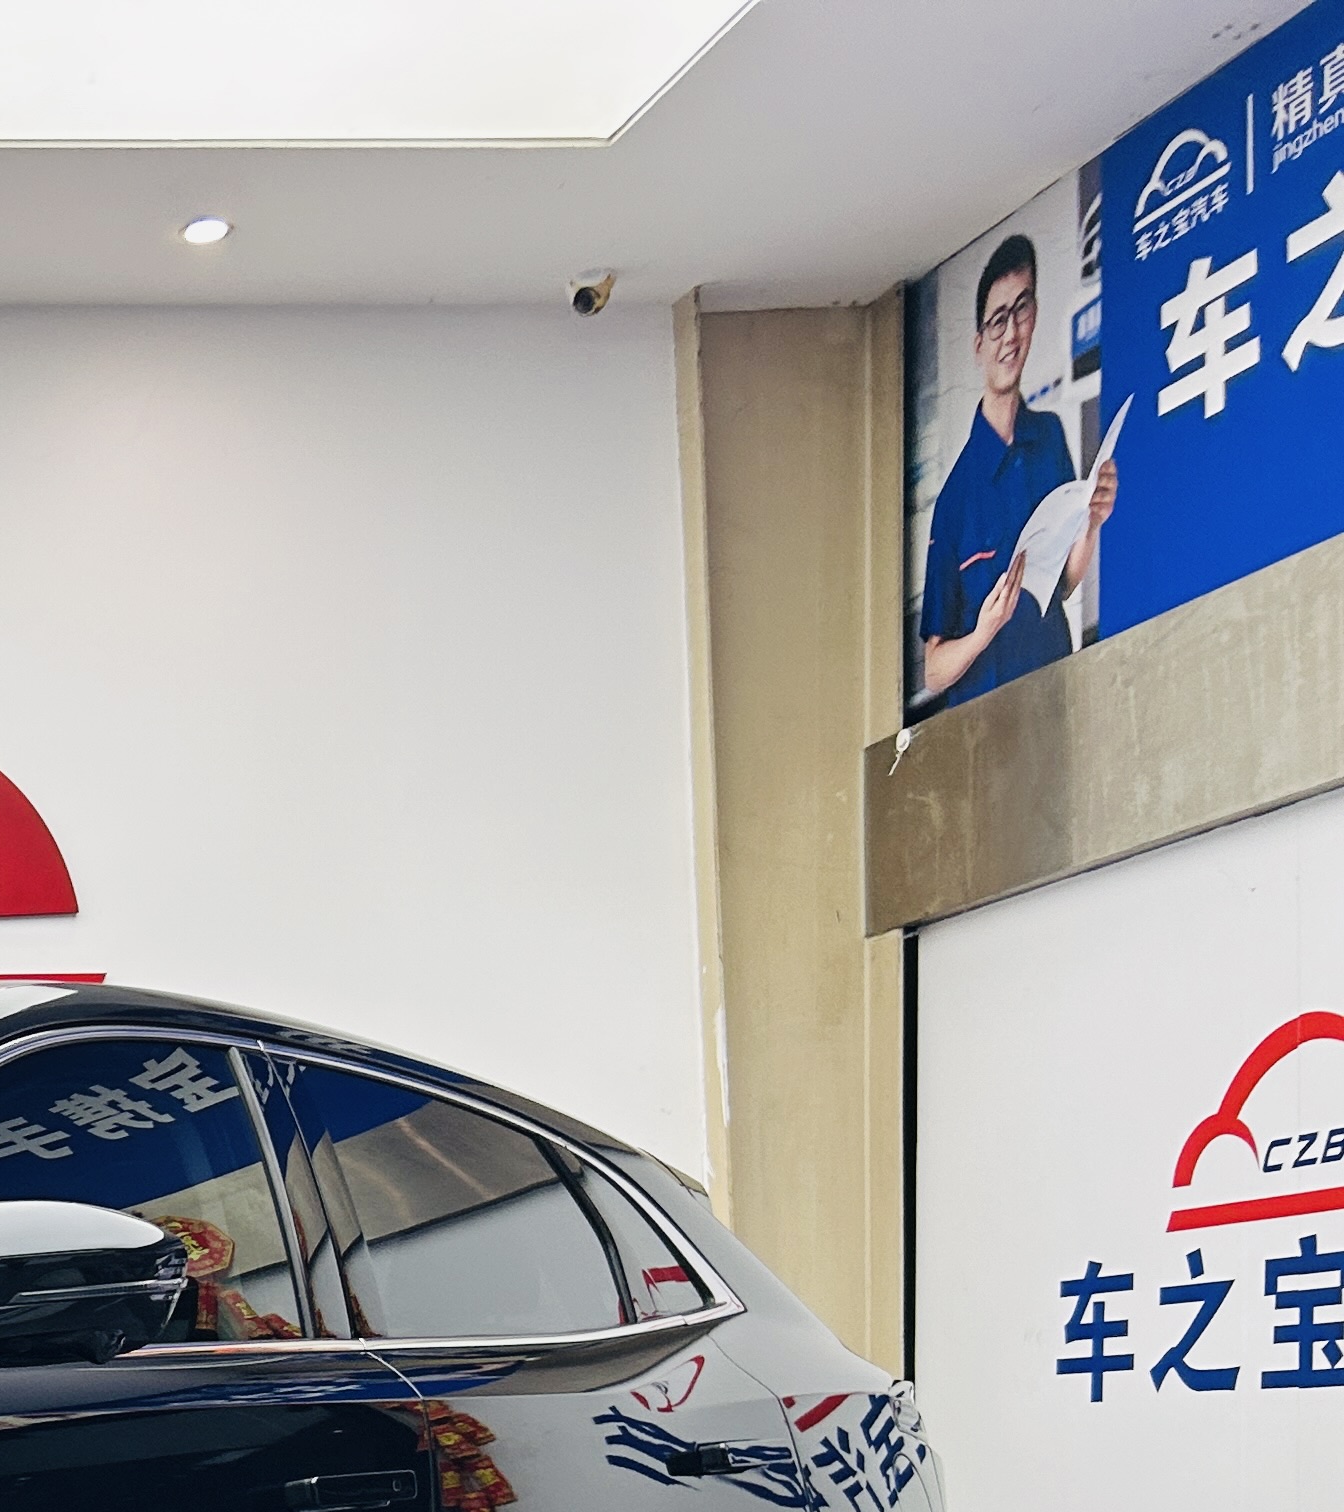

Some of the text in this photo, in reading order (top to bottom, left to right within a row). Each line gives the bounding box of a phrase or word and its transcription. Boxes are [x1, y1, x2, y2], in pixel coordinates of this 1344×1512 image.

[1134, 182, 1230, 261] 车之宝汽车
[1262, 1127, 1344, 1173] CZB
[1056, 1235, 1344, 1402] 车之宝
